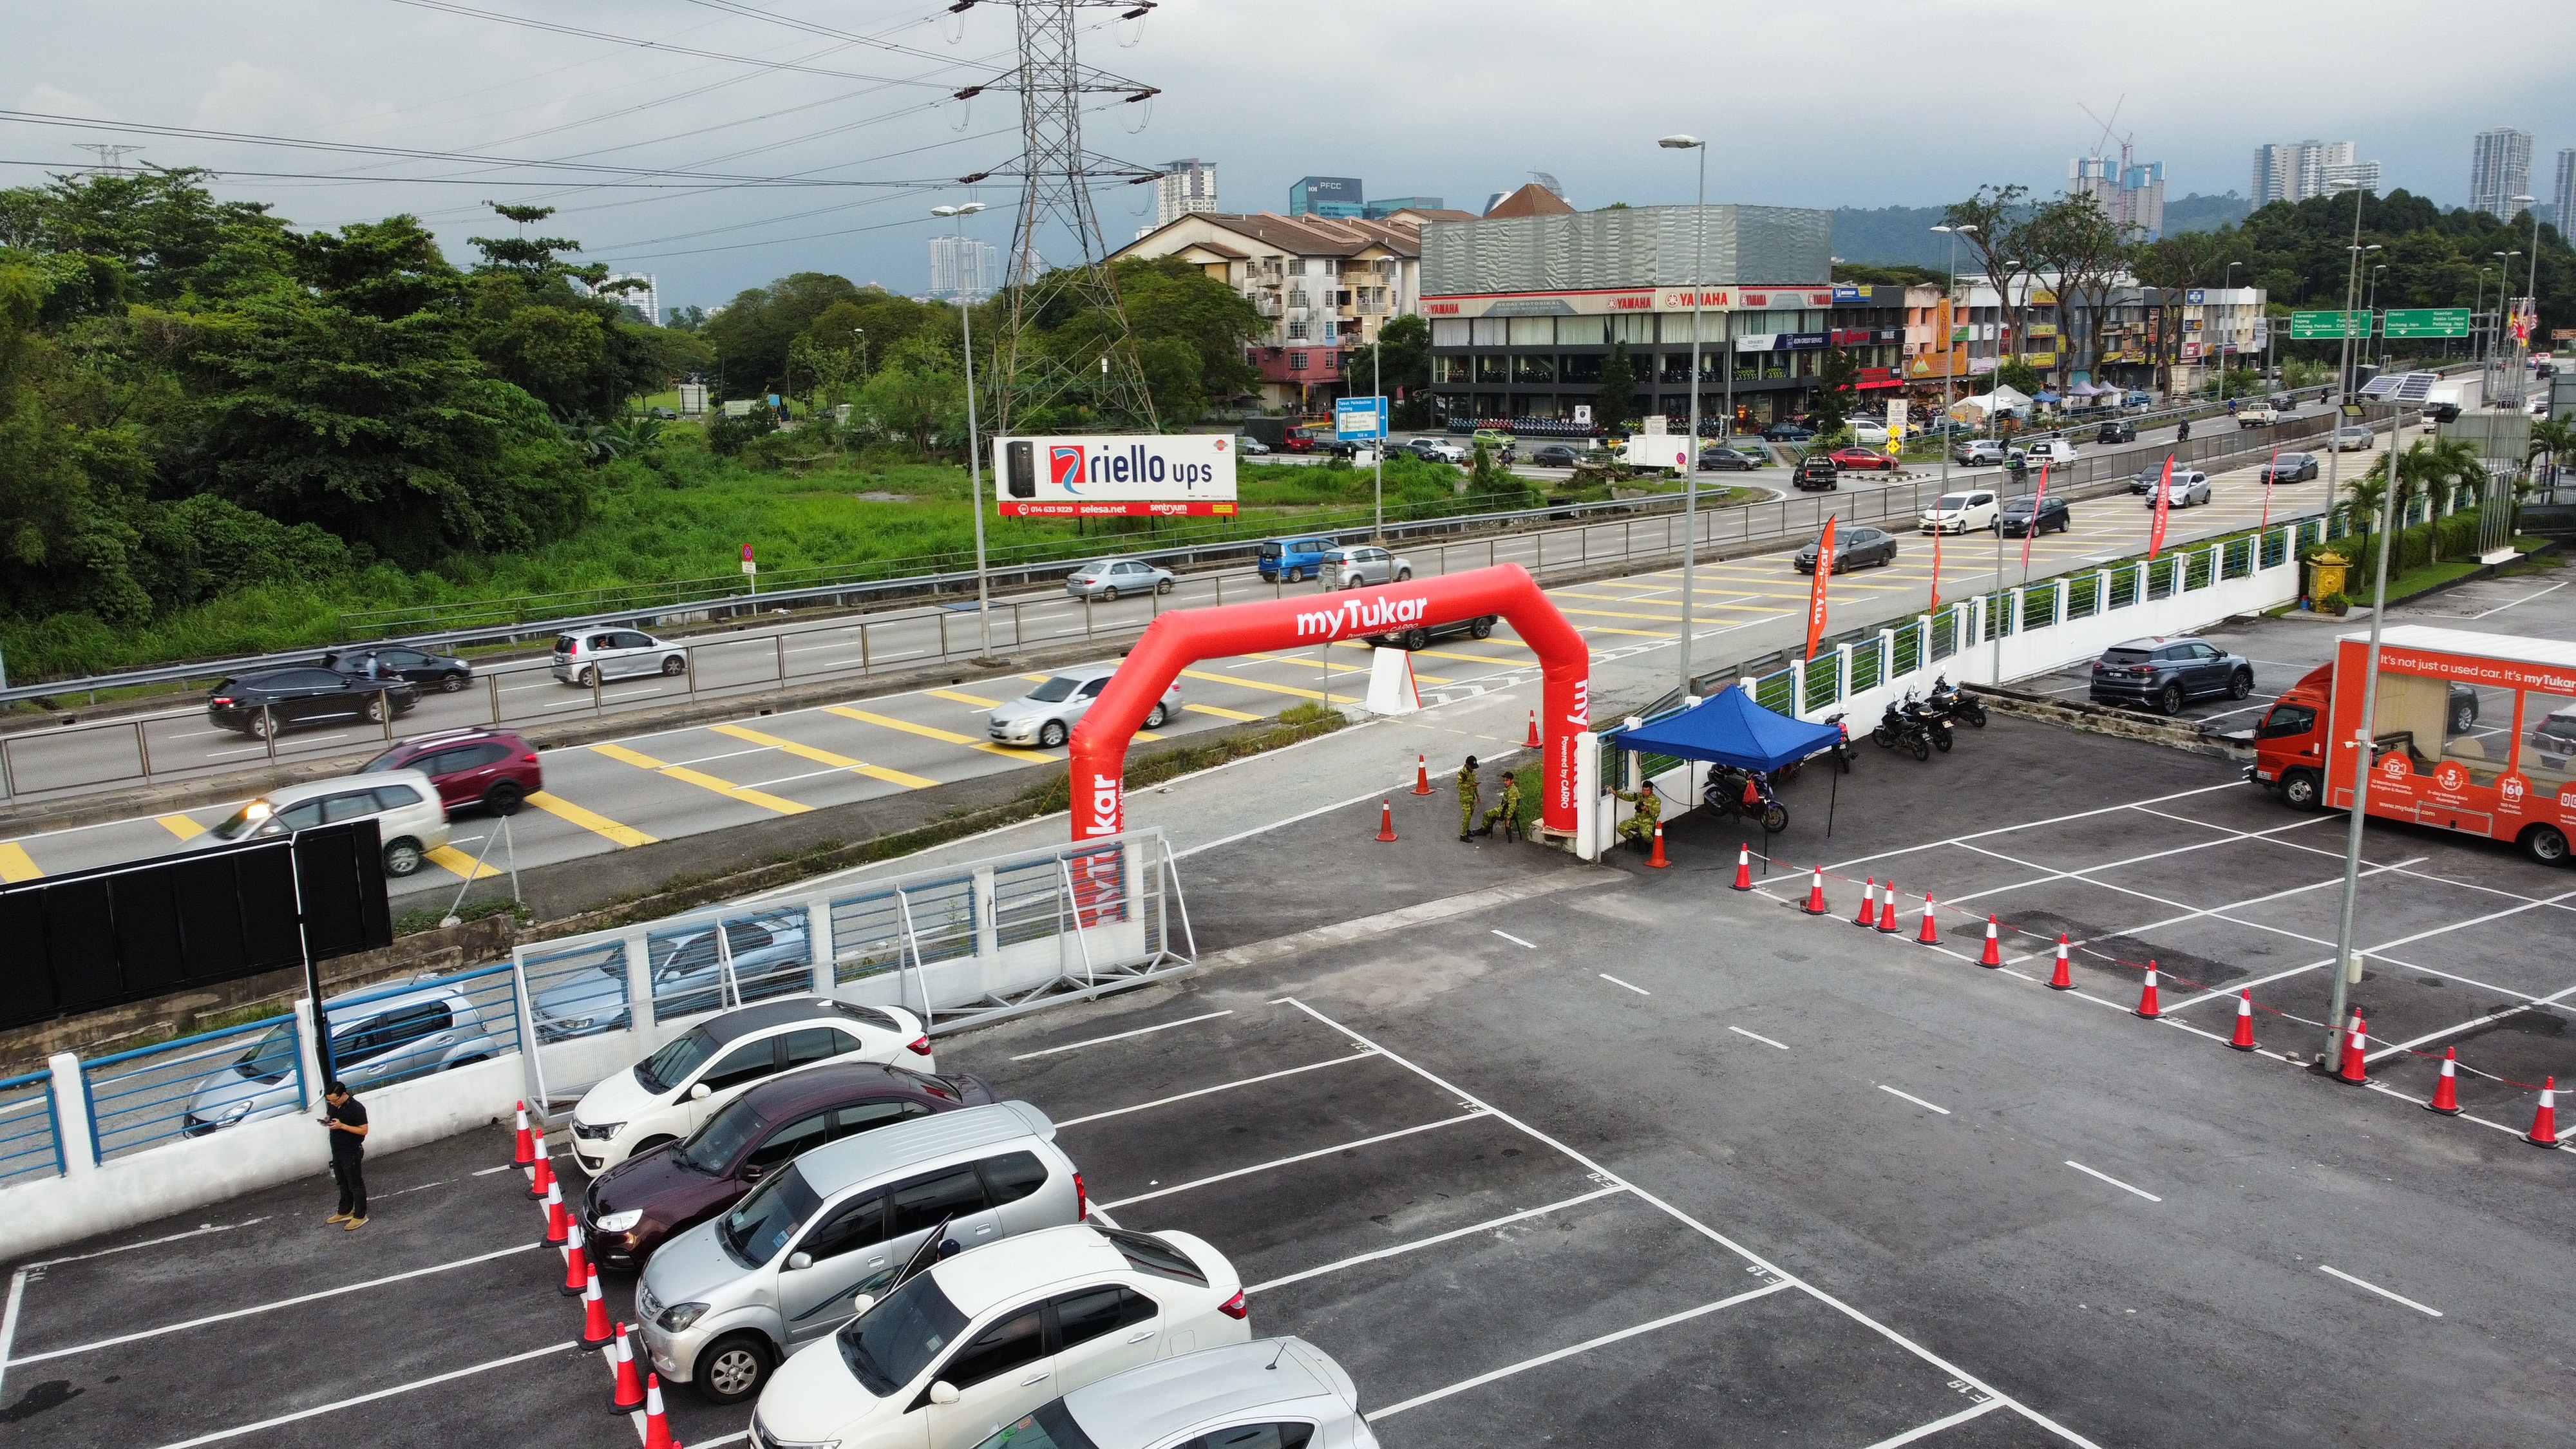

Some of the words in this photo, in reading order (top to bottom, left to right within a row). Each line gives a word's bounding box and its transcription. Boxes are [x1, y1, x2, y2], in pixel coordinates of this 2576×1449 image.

[1320, 182, 1341, 190] PFCC
[1617, 297, 1651, 309] YAMAHA
[1746, 294, 1767, 306] YAMAHA
[1430, 303, 1459, 314] YAMAHA
[1090, 444, 1165, 483] riello
[1173, 463, 1212, 490] ups
[1080, 505, 1127, 513] selesa.net
[1150, 503, 1188, 515] sentryum
[1296, 596, 1428, 639] myTukar
[1346, 629, 1379, 639] Powered
[1389, 622, 1419, 632] CARRO
[2380, 654, 2396, 666] It's
[2398, 656, 2416, 668] not
[2417, 659, 2438, 671] just
[2450, 665, 2478, 676] used
[2481, 668, 2503, 679] car.
[2505, 669, 2522, 681] It's
[1560, 735, 1569, 768] Powered
[1560, 769, 1567, 779] by
[2390, 764, 2400, 773] 12
[2447, 769, 2456, 781] 5
[1560, 779, 1571, 809] CARRO
[2502, 782, 2524, 797] 160
[1586, 1172, 1619, 1188] F20
